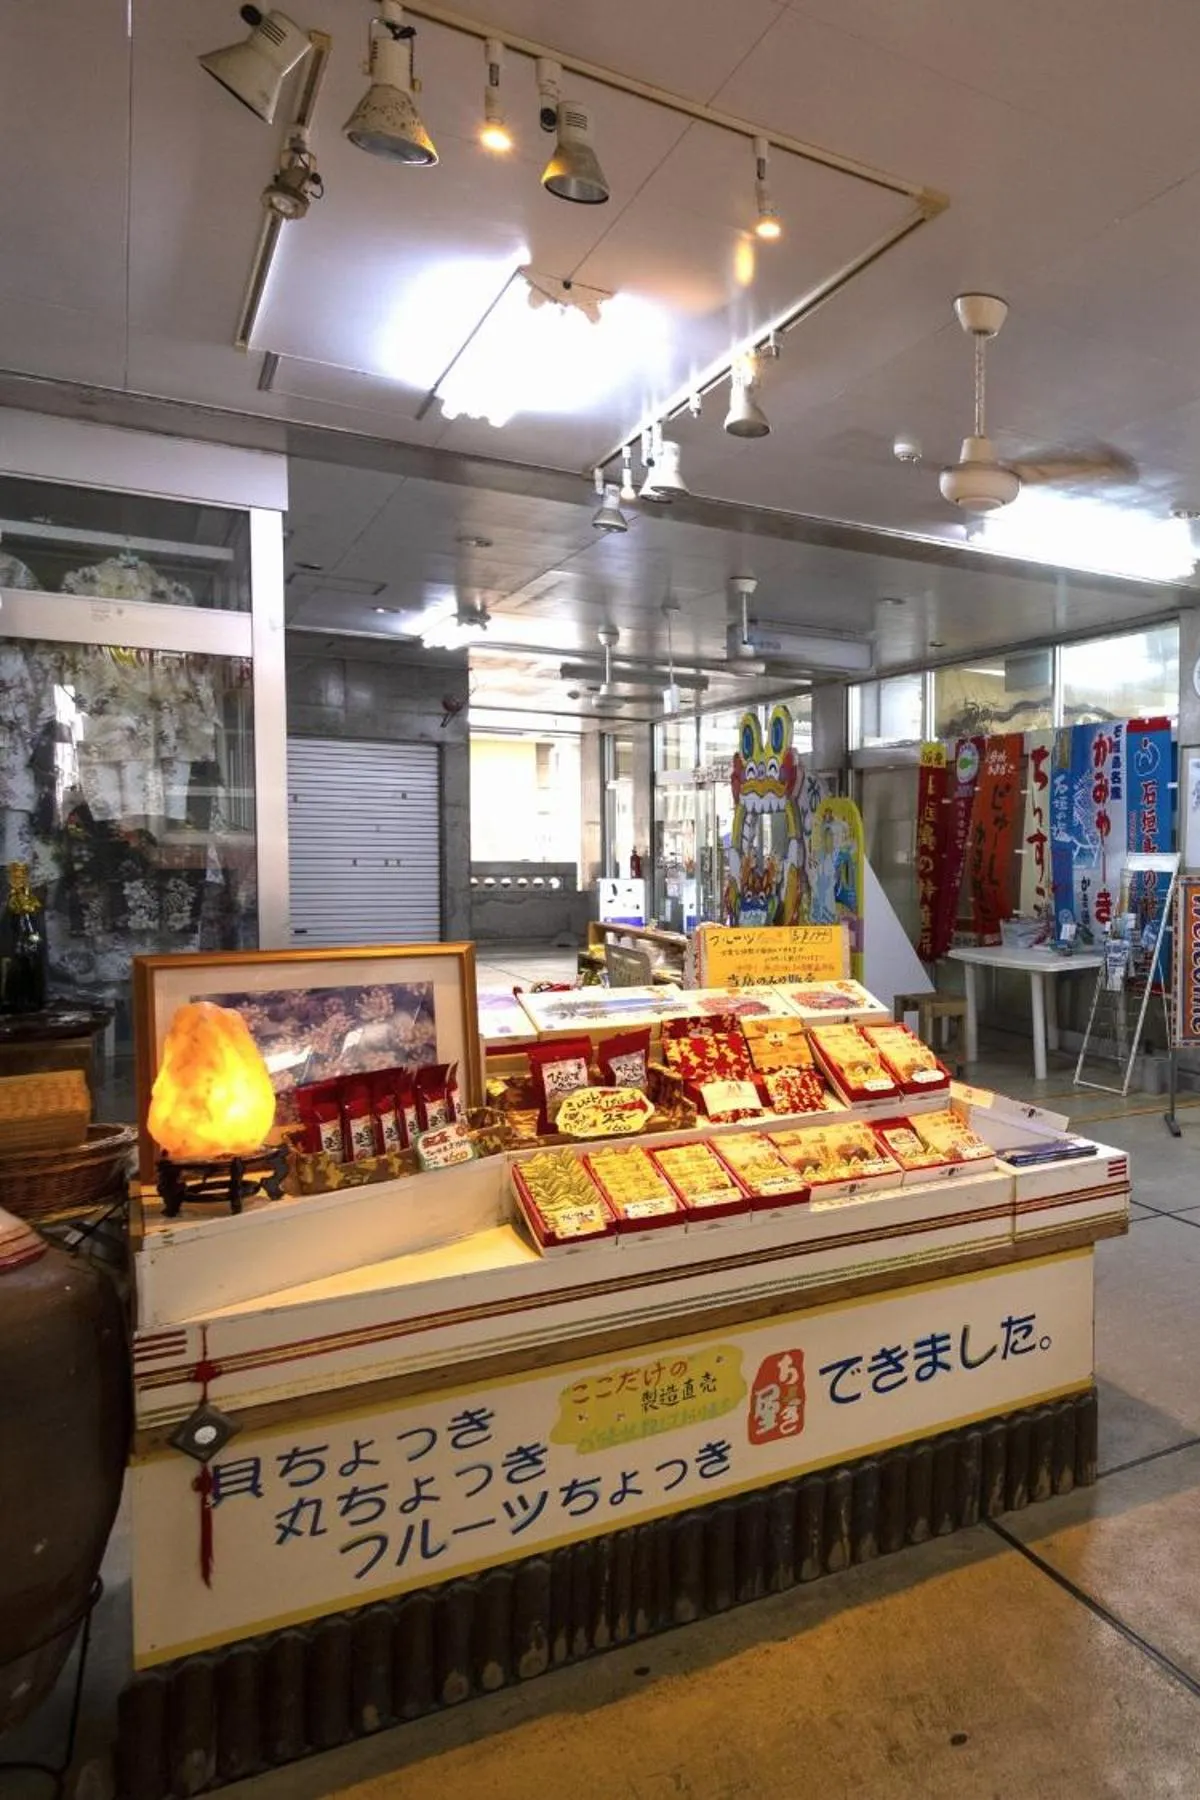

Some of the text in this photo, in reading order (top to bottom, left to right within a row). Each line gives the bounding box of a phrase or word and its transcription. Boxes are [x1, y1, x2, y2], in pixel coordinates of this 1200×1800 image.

[1027, 745, 1049, 918] ちんすこ
[572, 1360, 688, 1404] ここだけの
[641, 1371, 717, 1413] 製造直売
[818, 1312, 1052, 1405] できました。
